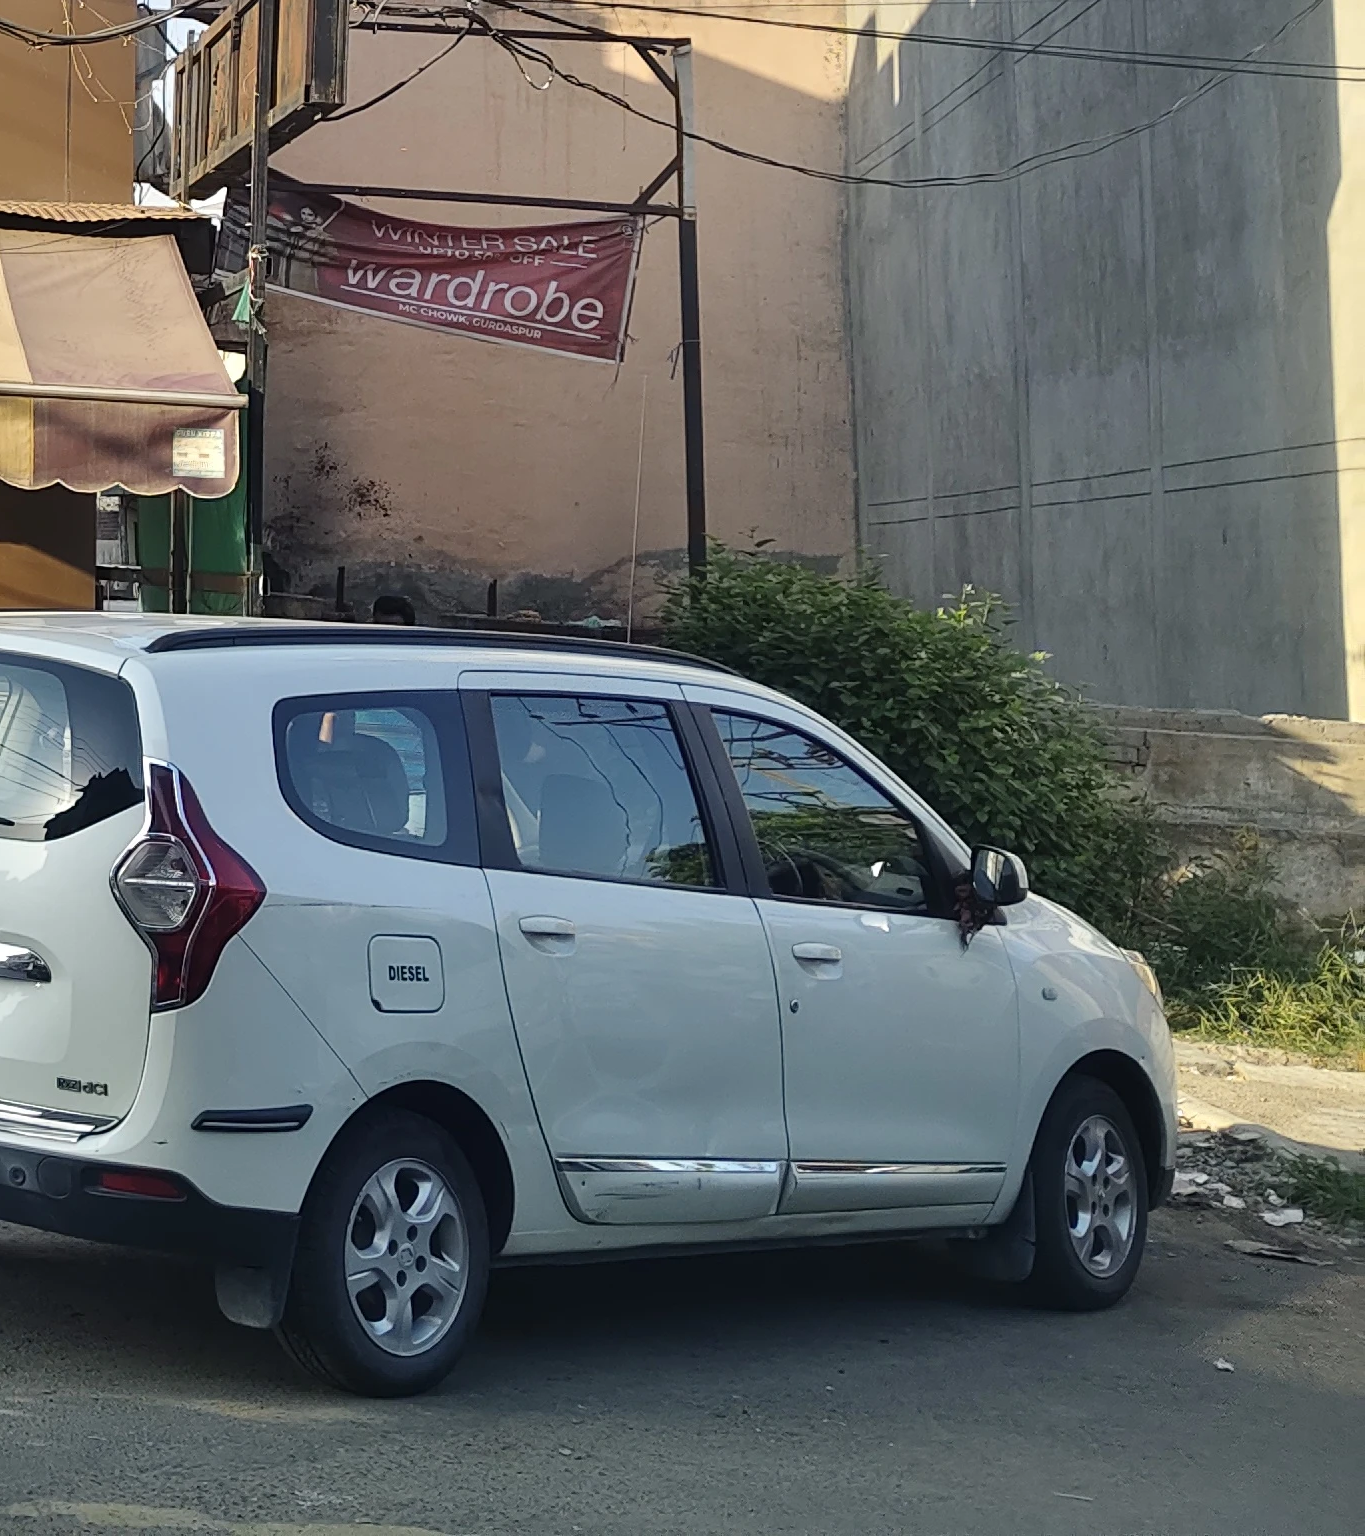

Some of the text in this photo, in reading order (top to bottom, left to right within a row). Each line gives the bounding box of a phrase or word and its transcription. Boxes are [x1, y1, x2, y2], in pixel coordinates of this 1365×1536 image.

[371, 219, 600, 259] WINTER SALE
[346, 258, 604, 331] wardrobe
[398, 303, 542, 340] MC CHOWK, GURDASPUR
[388, 964, 430, 983] DIESEL
